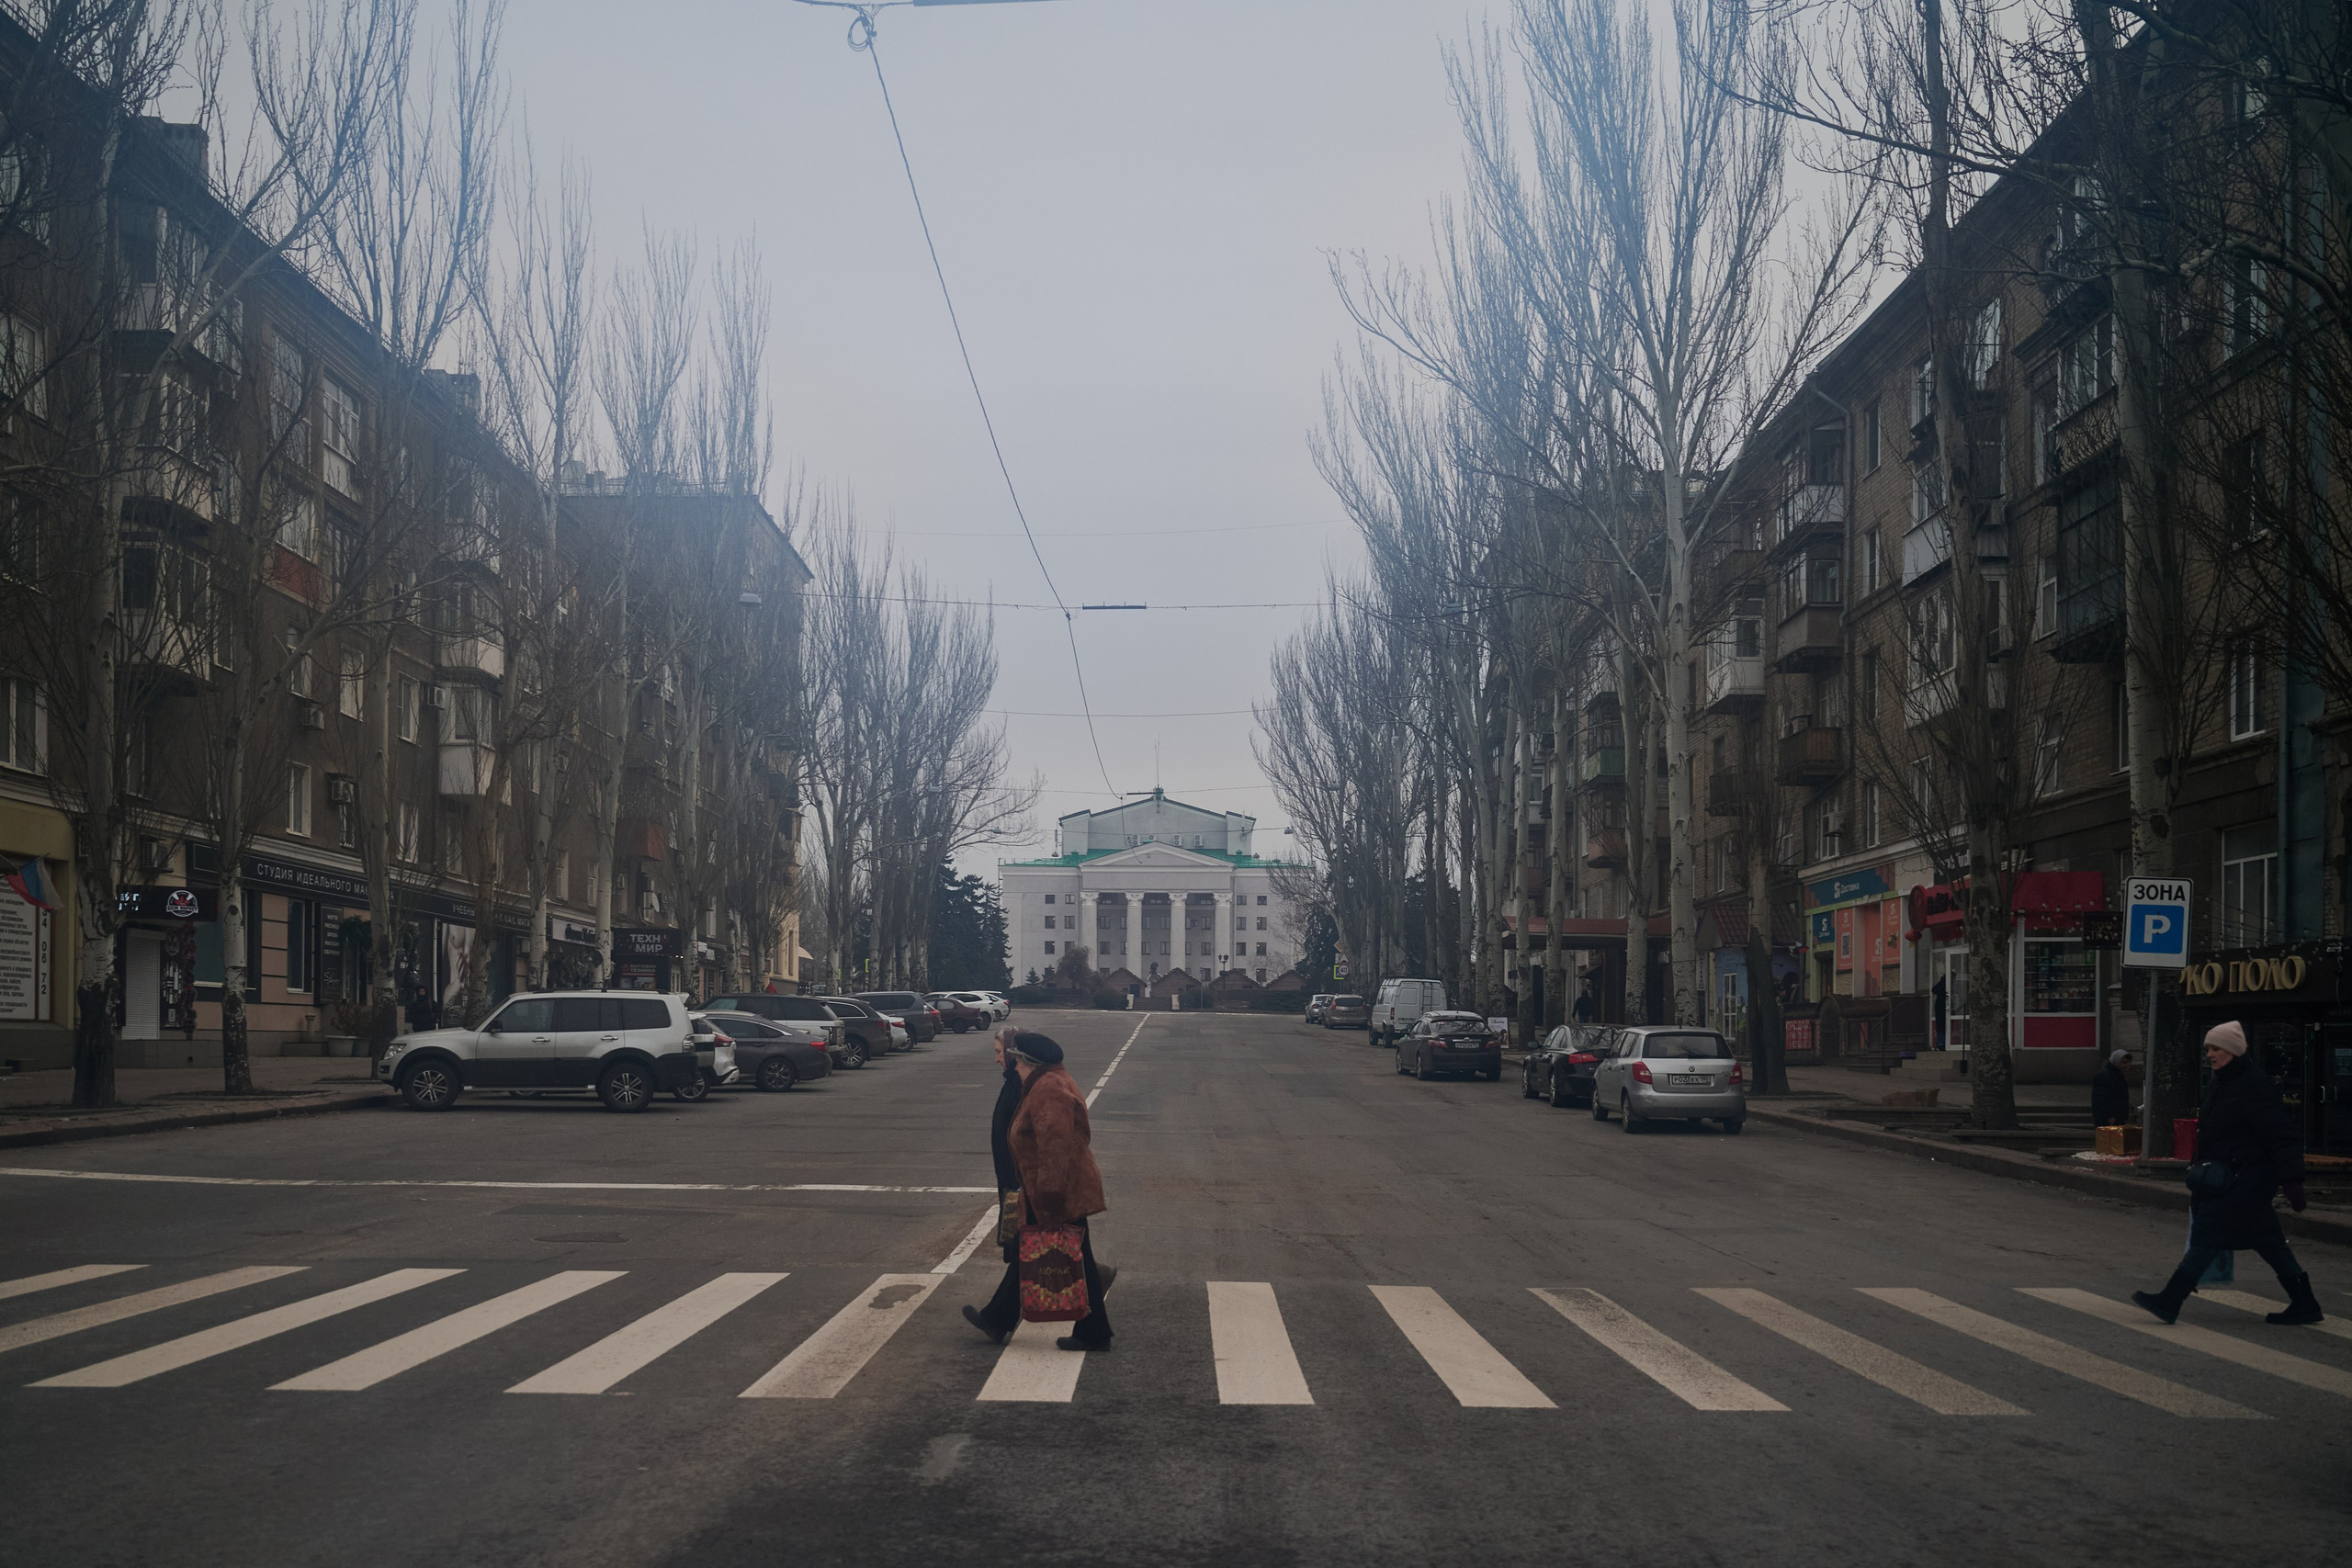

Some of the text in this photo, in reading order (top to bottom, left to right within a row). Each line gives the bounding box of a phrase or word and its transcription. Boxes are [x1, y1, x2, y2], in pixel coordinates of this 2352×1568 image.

[256, 863, 294, 881] СТУДИЯ
[296, 871, 352, 893] ИДЕАЛЬНОГО
[2133, 885, 2186, 901] ЗОНА
[2143, 914, 2171, 943] P
[635, 943, 663, 953] МИР
[2228, 955, 2306, 993] ПОЛО
